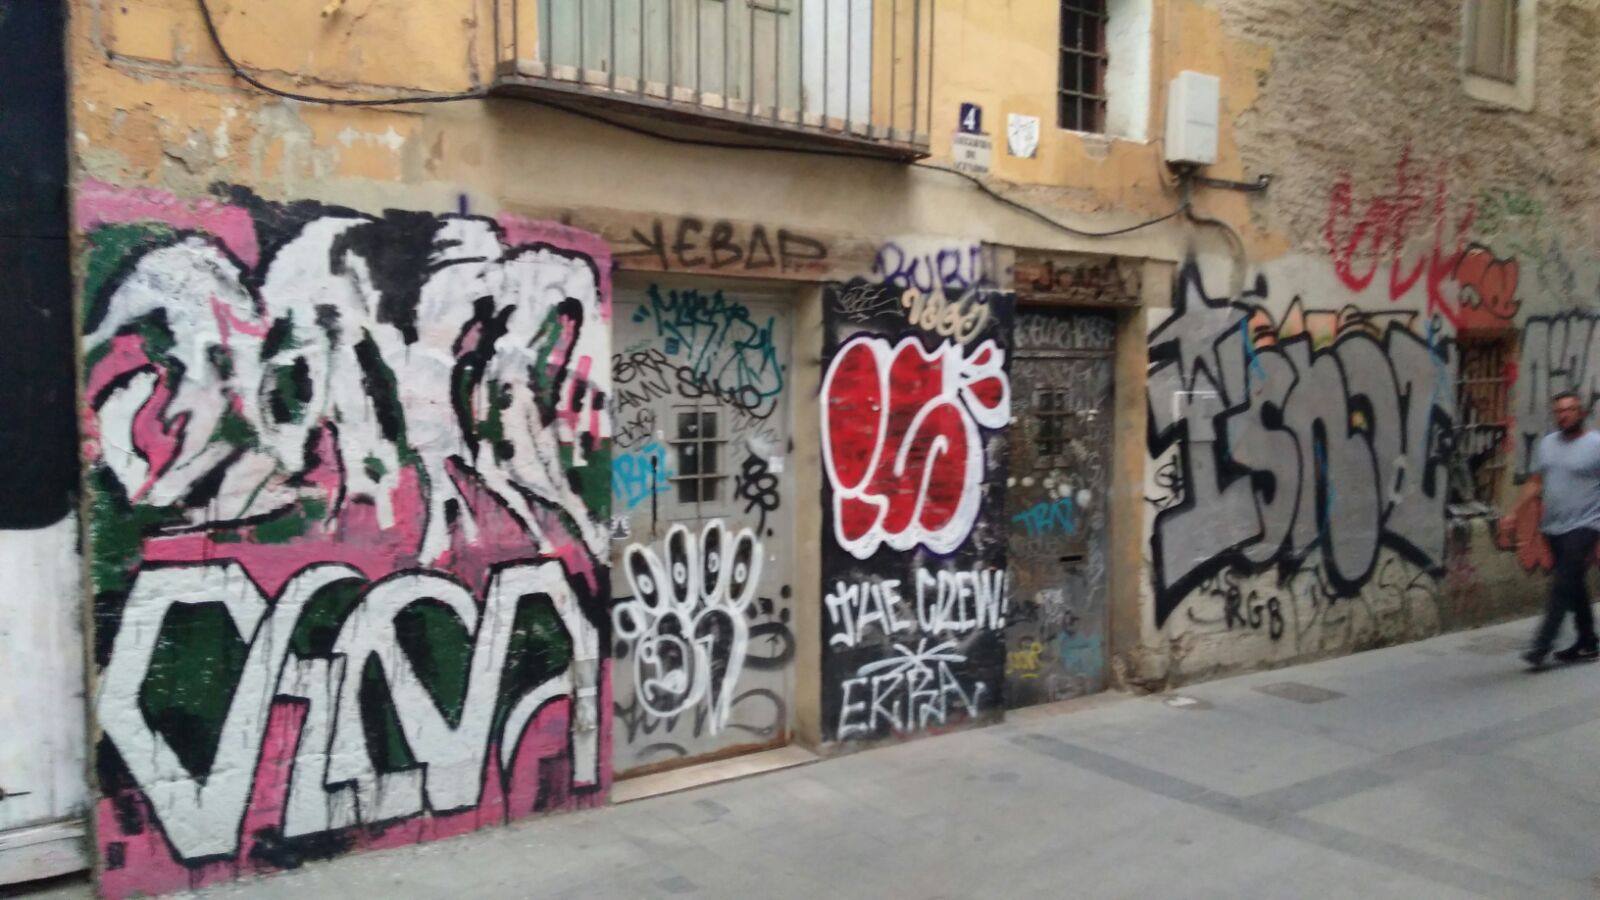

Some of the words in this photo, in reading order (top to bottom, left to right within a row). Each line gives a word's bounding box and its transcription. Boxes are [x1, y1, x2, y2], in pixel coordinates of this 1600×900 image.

[962, 106, 977, 131] 4
[915, 566, 1009, 635] CREW!
[1224, 585, 1284, 642] RGB
